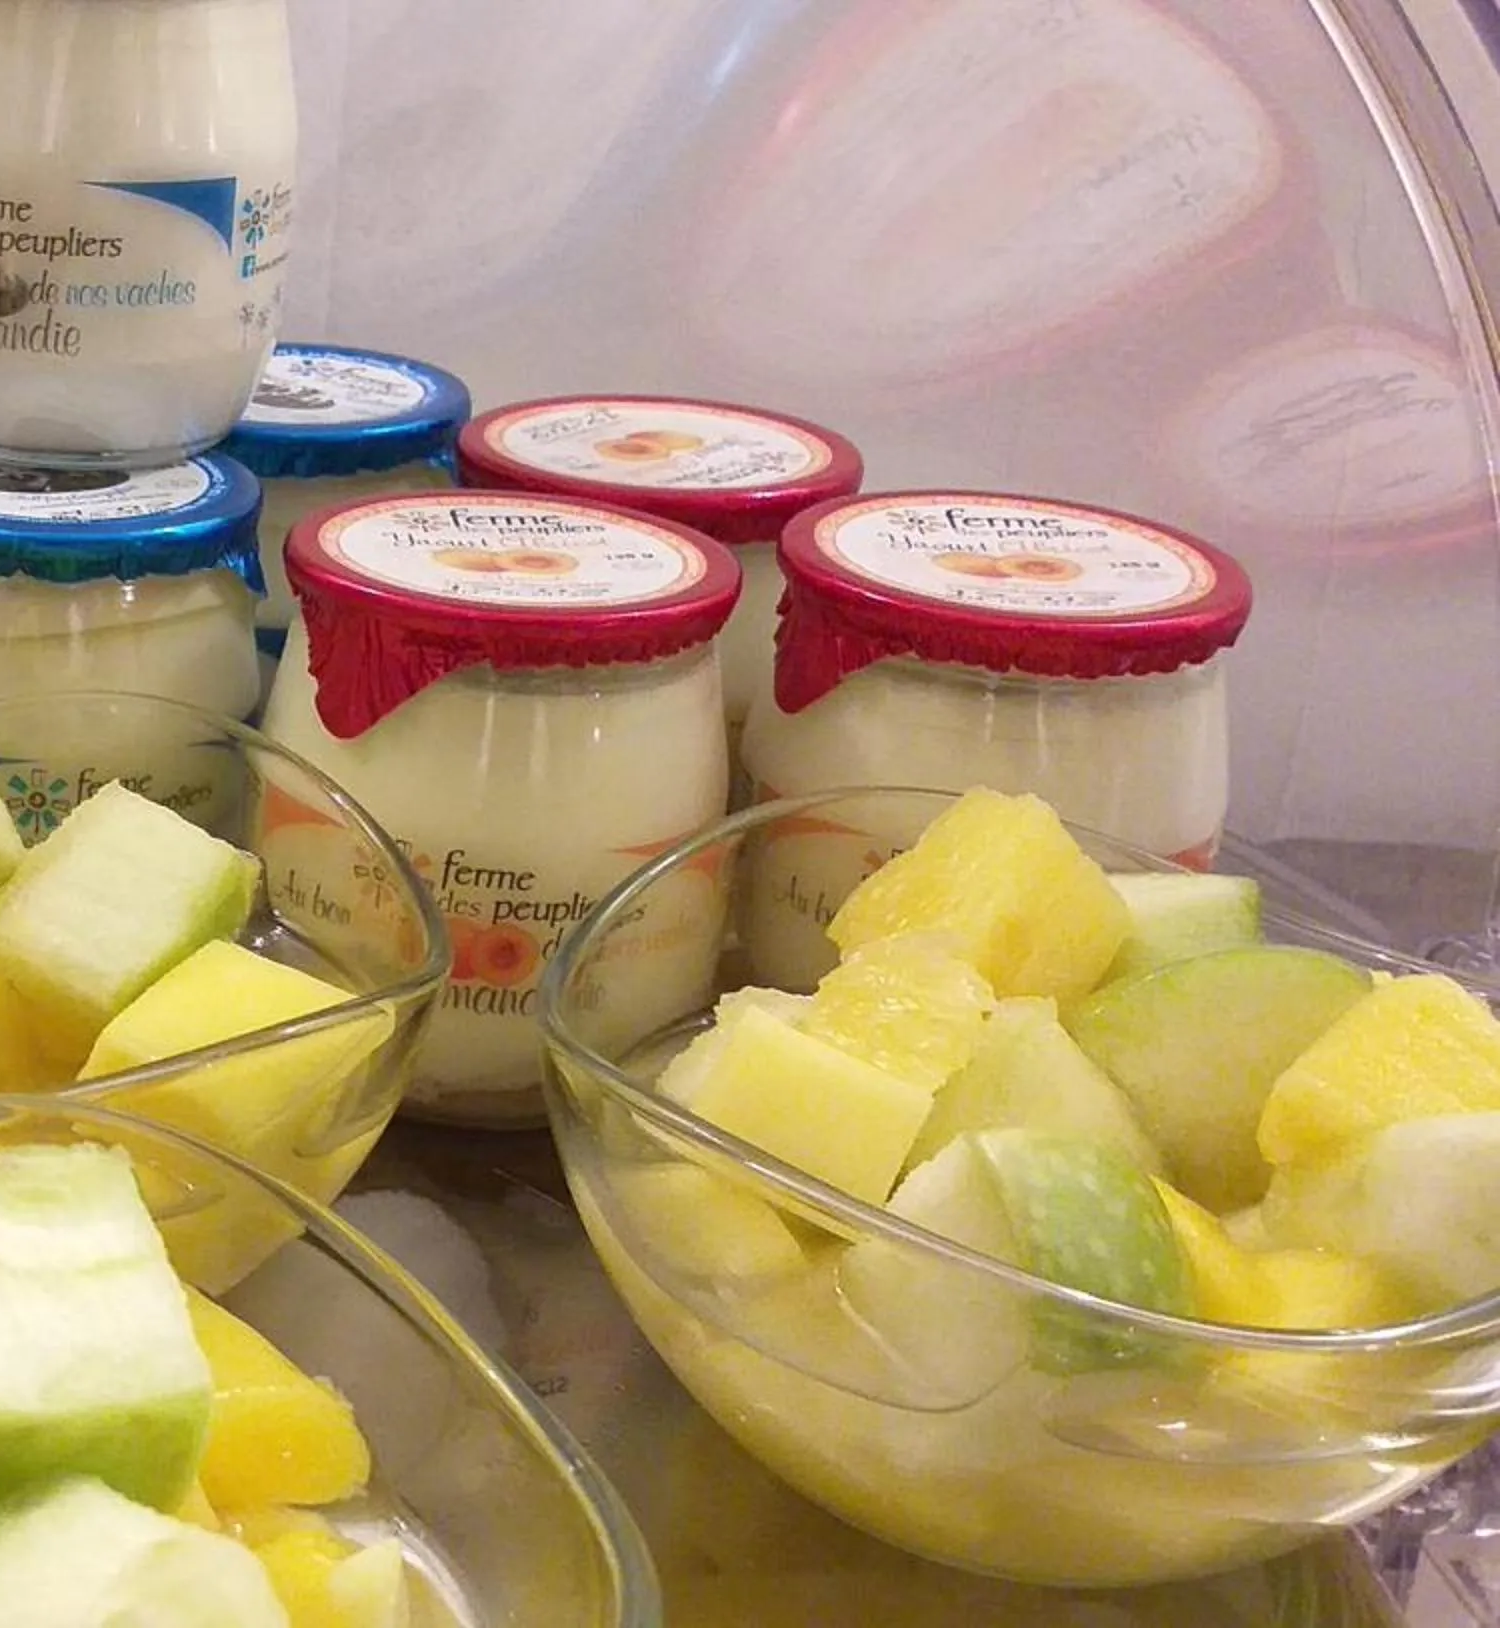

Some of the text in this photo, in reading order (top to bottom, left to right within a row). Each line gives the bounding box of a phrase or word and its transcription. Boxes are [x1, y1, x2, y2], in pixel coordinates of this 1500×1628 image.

[0, 227, 123, 262] peupliers
[29, 269, 60, 305] de
[66, 281, 107, 307] nos
[115, 270, 195, 307] vaches
[450, 508, 561, 529] ferme
[499, 521, 606, 535] peupliers
[945, 508, 1062, 528] ferme
[382, 530, 488, 548] Yaourt
[878, 531, 988, 552] Yaourt
[1000, 527, 1108, 541] peupliers
[441, 849, 535, 892] ferme
[312, 893, 351, 926] bon
[437, 896, 481, 917] des
